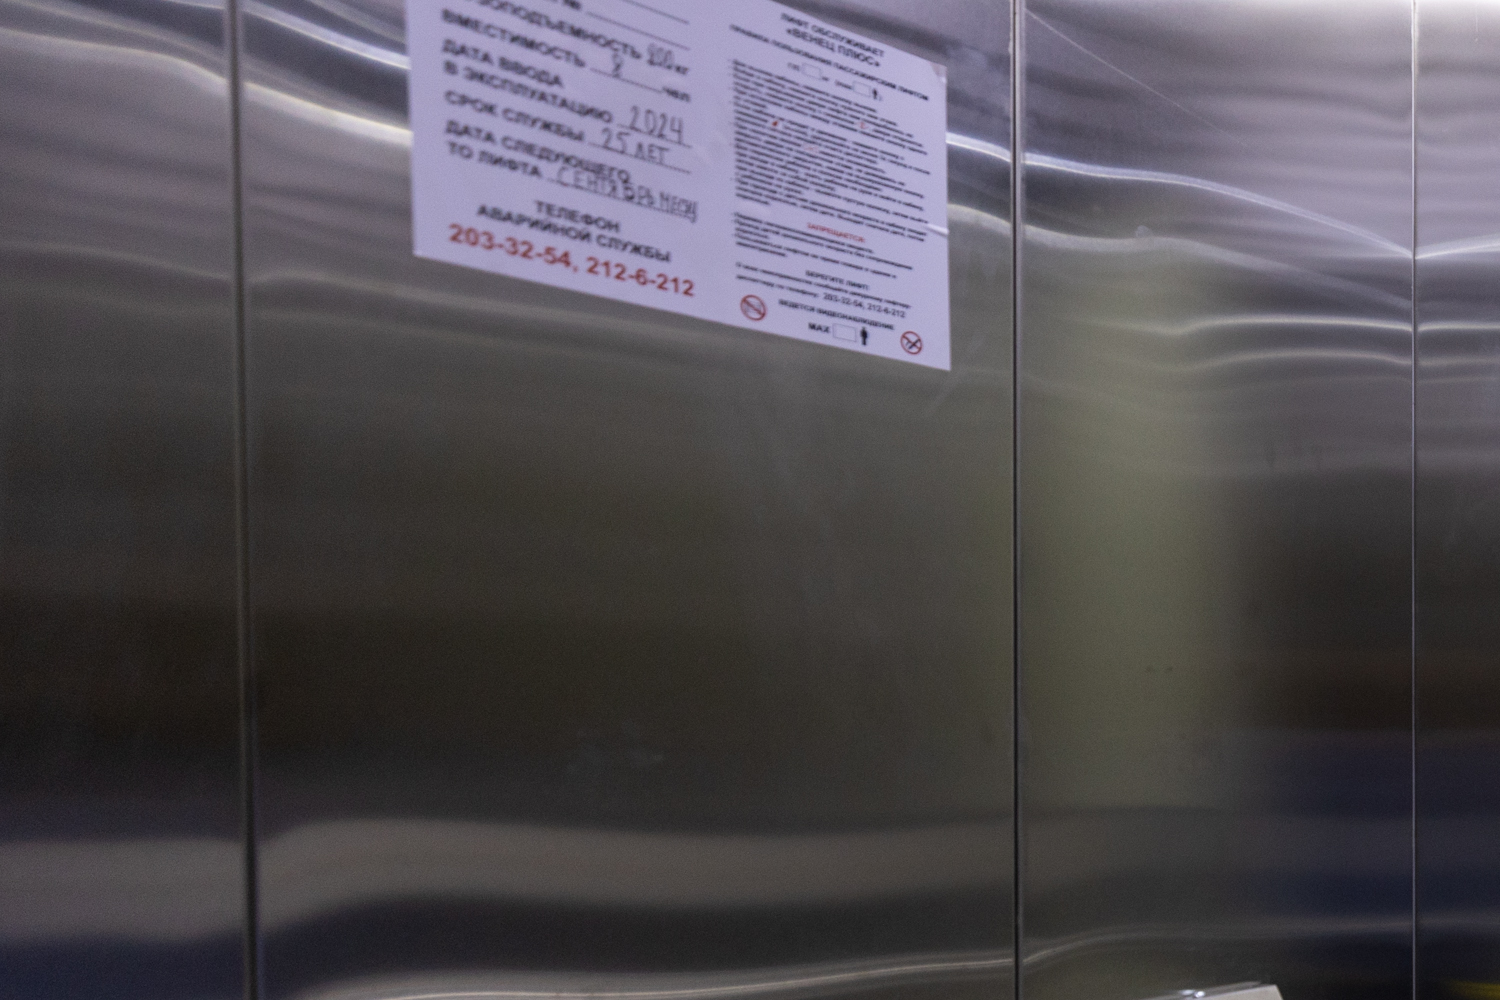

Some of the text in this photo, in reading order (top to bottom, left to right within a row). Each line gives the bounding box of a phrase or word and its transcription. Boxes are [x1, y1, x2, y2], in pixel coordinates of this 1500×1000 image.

[441, 8, 586, 68] ВМЕСТИМОСТЬ
[786, 27, 881, 68] «ВЕНЕЦ ПЛЮС»
[810, 24, 885, 57] ОБСЛУЖИВАЕТ
[442, 39, 565, 88] ДАТА ВВОДА
[443, 59, 613, 123] В ЭКСПЛУАТАЦИЮ
[444, 90, 585, 142] СРОК СЛУЖБЫ
[629, 104, 685, 145] 2024
[446, 119, 631, 183] ДАТА СЛЕДУЮЩЕГО
[447, 141, 543, 179] ТО ЛИФТА
[602, 126, 631, 154] 25
[476, 204, 671, 263] АВАРИЙНОЙ СЛУЖБЫ
[533, 200, 621, 233] ТЕЛЕФОН
[448, 223, 579, 273] 203-32-54,
[586, 256, 695, 297] 212-6-212
[866, 301, 906, 319] 212-6-212
